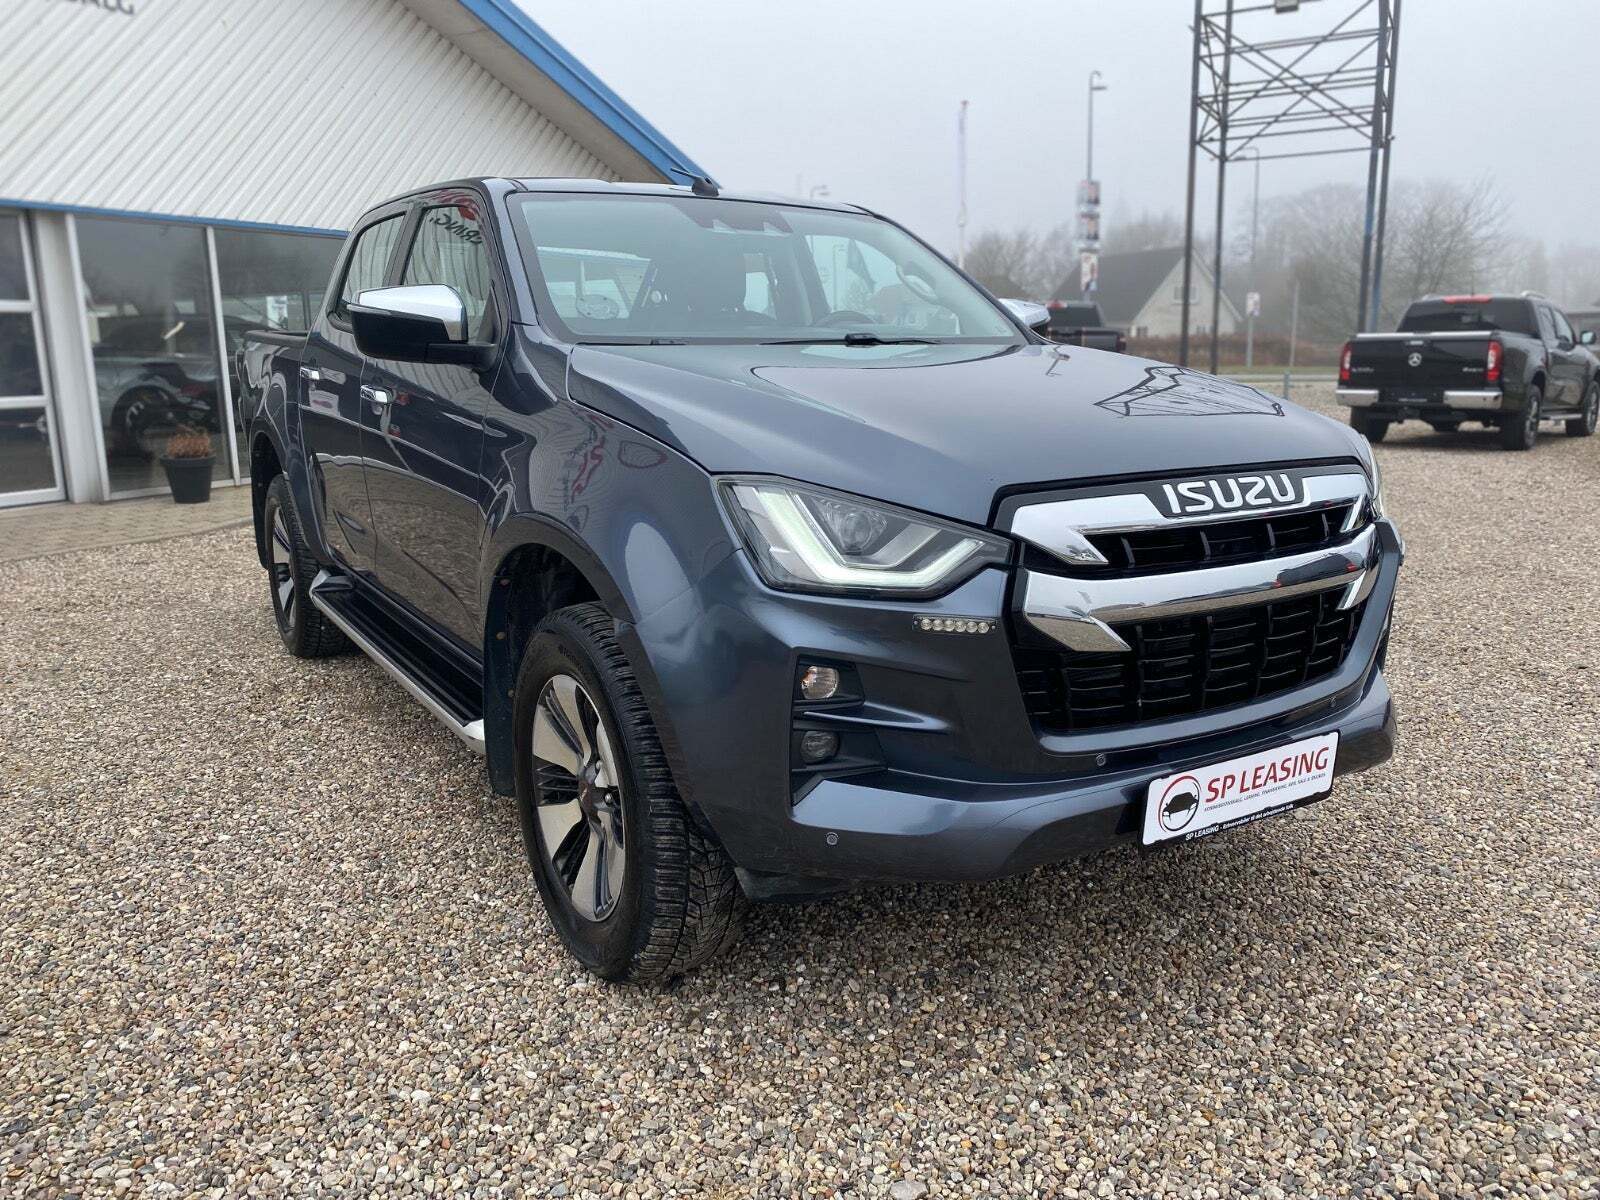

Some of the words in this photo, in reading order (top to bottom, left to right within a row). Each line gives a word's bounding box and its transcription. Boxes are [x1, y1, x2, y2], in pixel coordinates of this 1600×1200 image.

[1162, 473, 1296, 514] ISUZU
[1205, 774, 1236, 803] SP
[1240, 746, 1330, 793] LEASING
